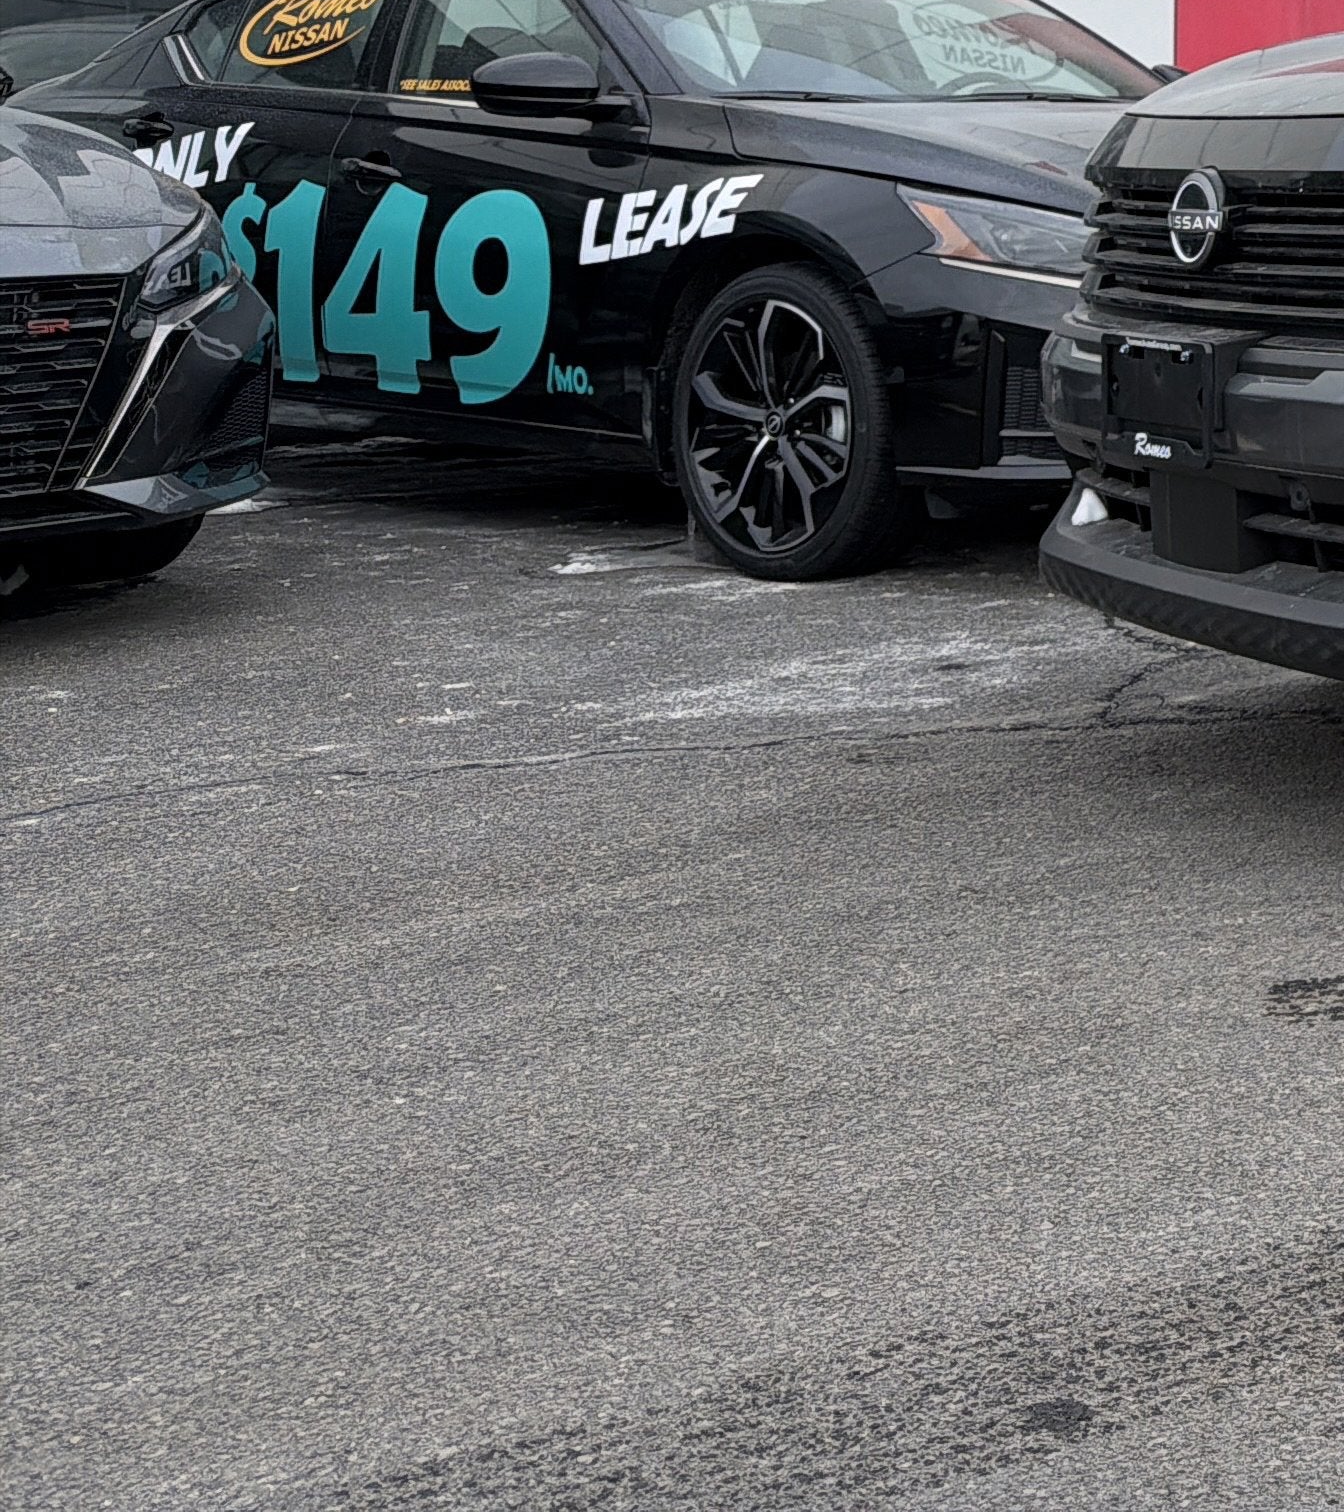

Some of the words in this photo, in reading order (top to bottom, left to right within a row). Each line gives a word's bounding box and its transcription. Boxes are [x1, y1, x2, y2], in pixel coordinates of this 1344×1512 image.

[267, 18, 349, 55] NISSAN
[579, 174, 764, 265] LEASE
[222, 178, 551, 405] $149
[28, 318, 70, 335] SR
